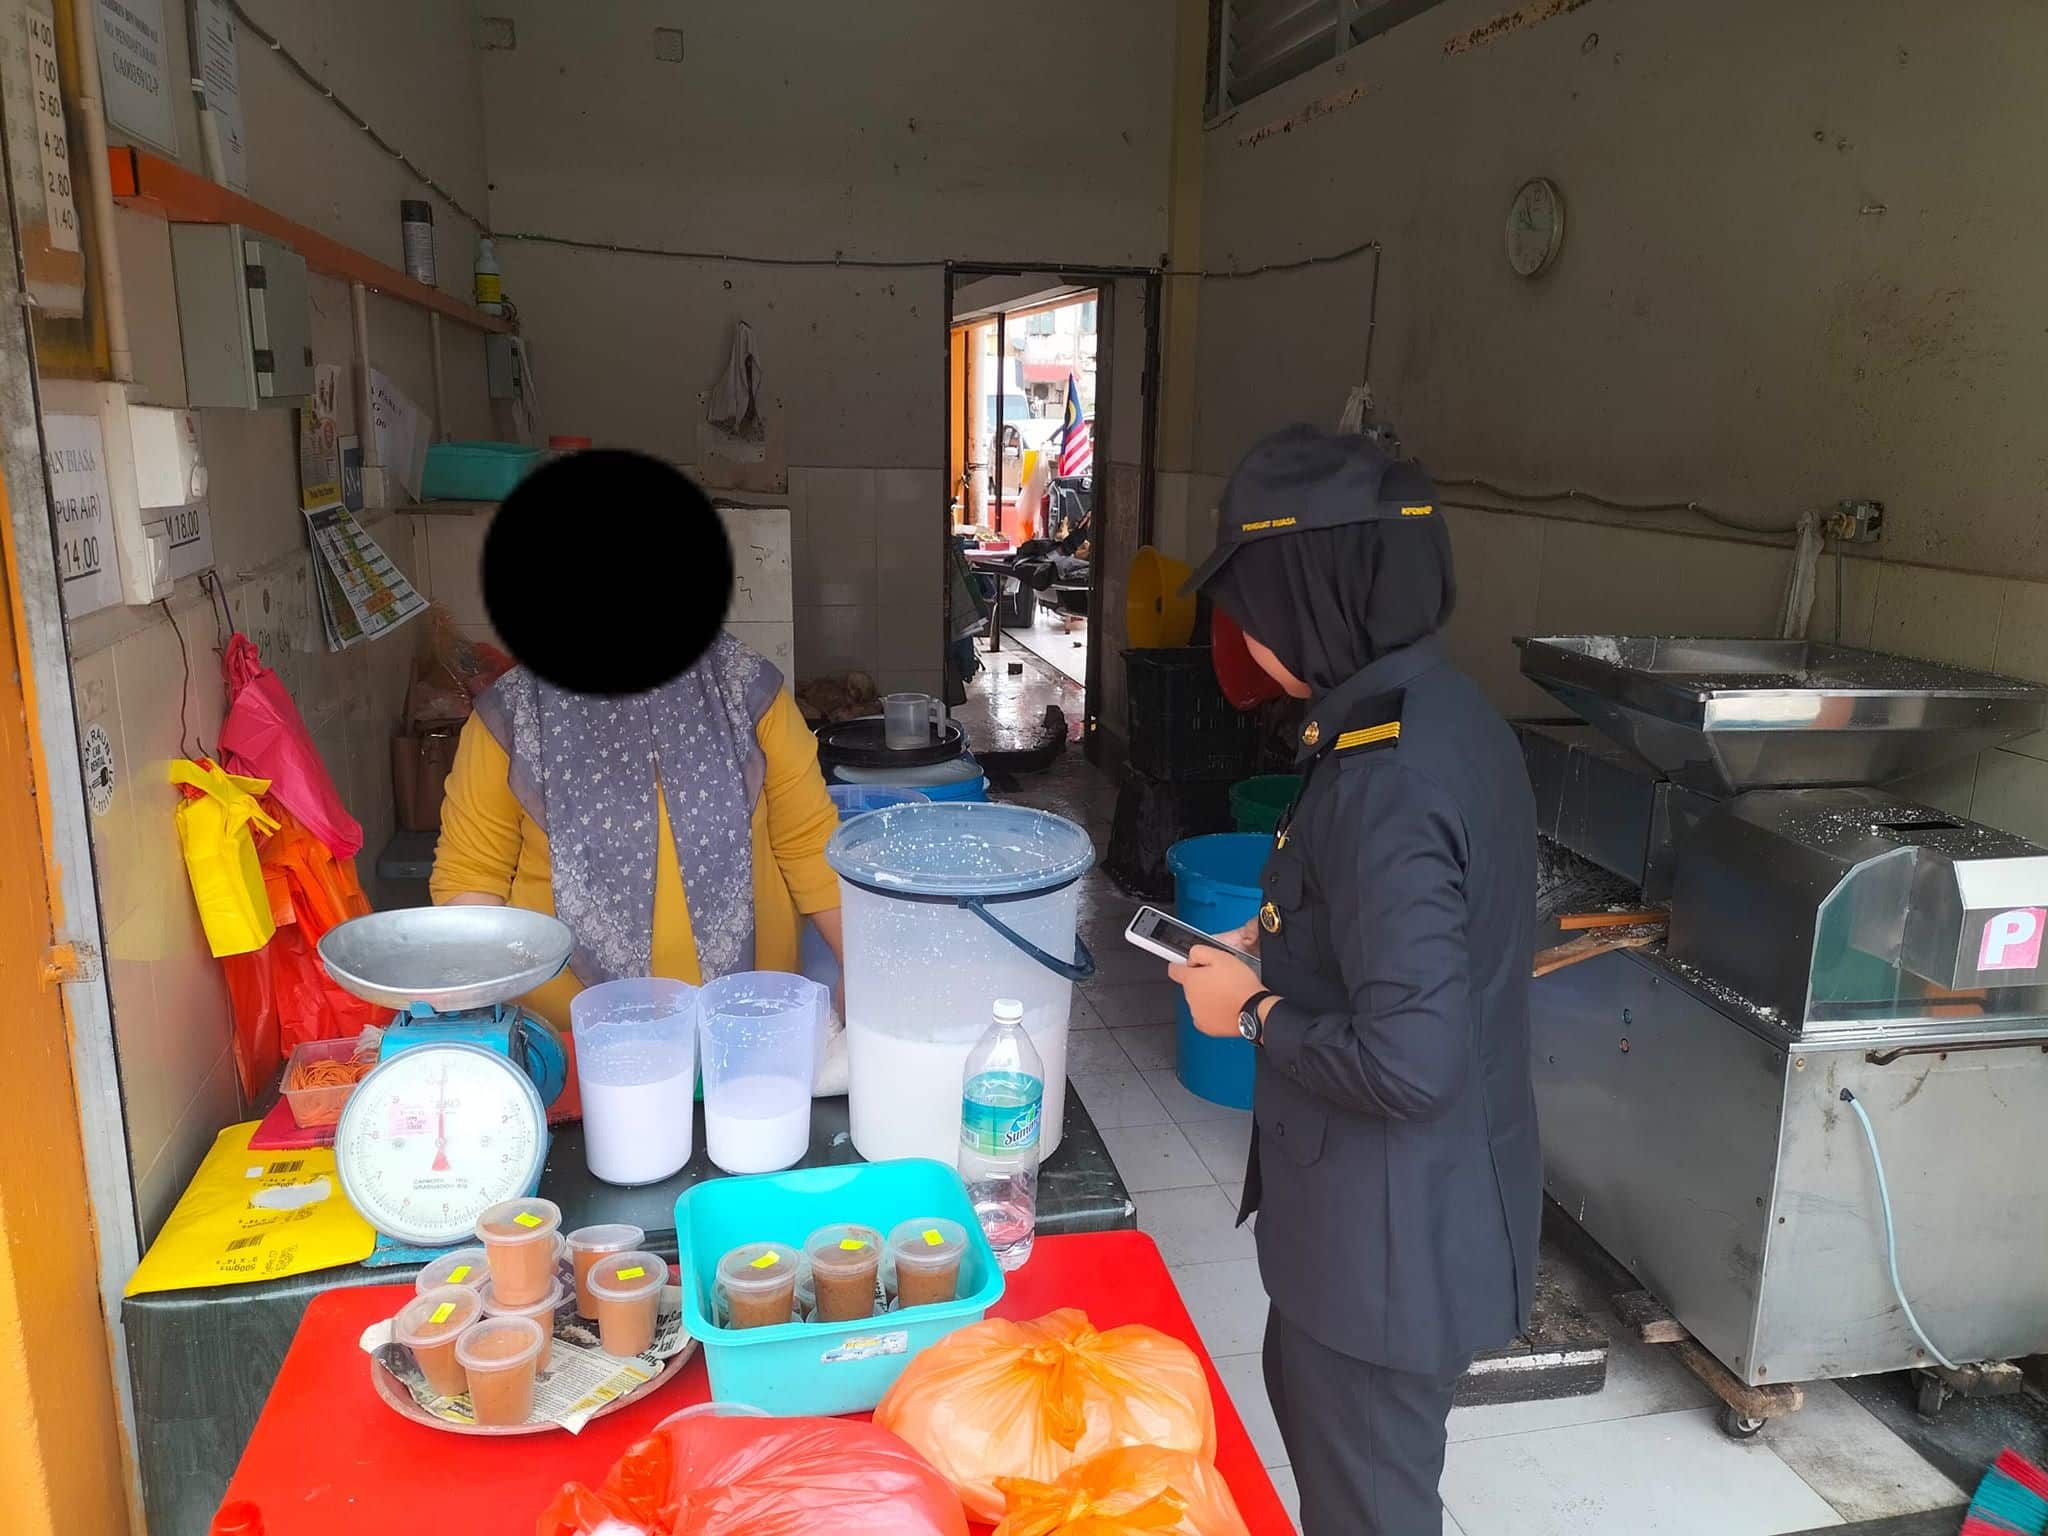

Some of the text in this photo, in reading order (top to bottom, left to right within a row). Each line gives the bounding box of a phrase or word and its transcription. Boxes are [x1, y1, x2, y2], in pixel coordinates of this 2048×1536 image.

[48, 171, 70, 198] 2.80
[64, 448, 96, 473] BIASA
[174, 509, 200, 541] 18.00
[63, 535, 100, 573] 14.00
[1983, 911, 2037, 965] P
